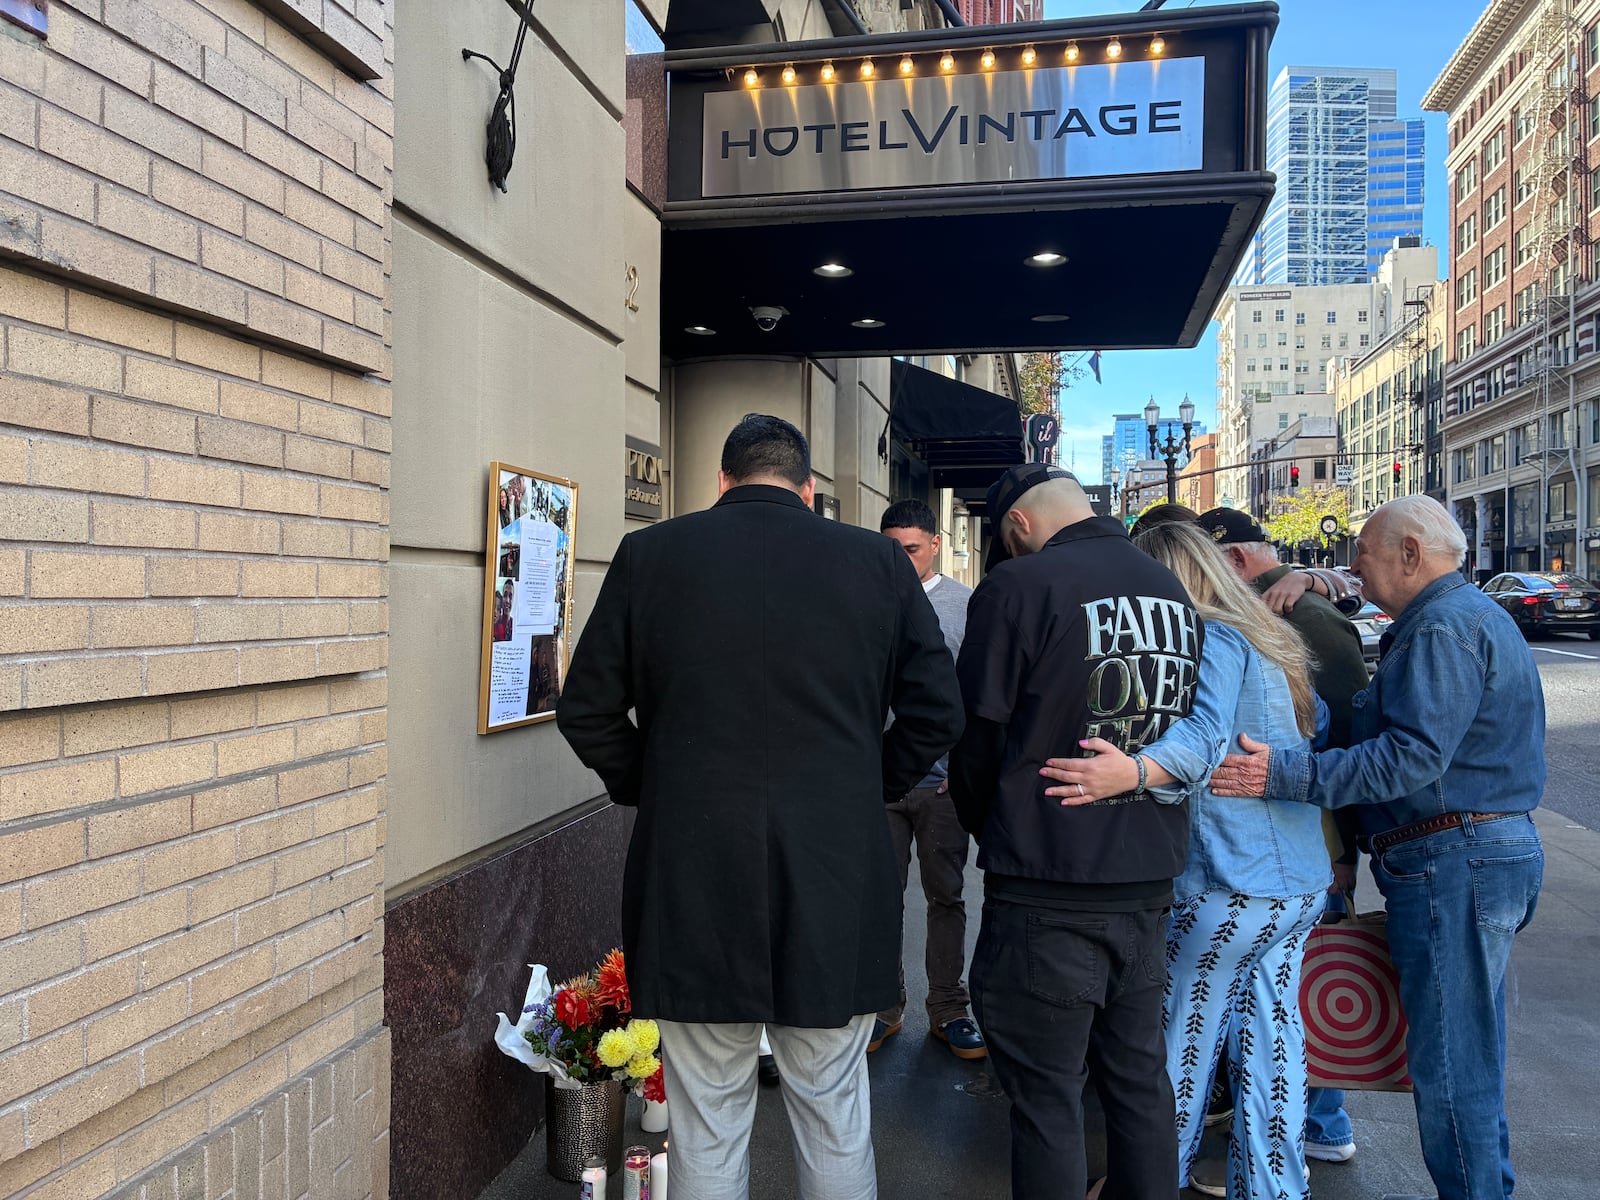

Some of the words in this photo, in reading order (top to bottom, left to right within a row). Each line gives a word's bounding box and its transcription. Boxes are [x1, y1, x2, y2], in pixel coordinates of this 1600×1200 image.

[625, 261, 640, 313] 2
[1086, 493, 1101, 503] LL
[1081, 595, 1199, 662] FAITH
[1087, 653, 1199, 717] OVER
[1084, 713, 1182, 758] FEA
